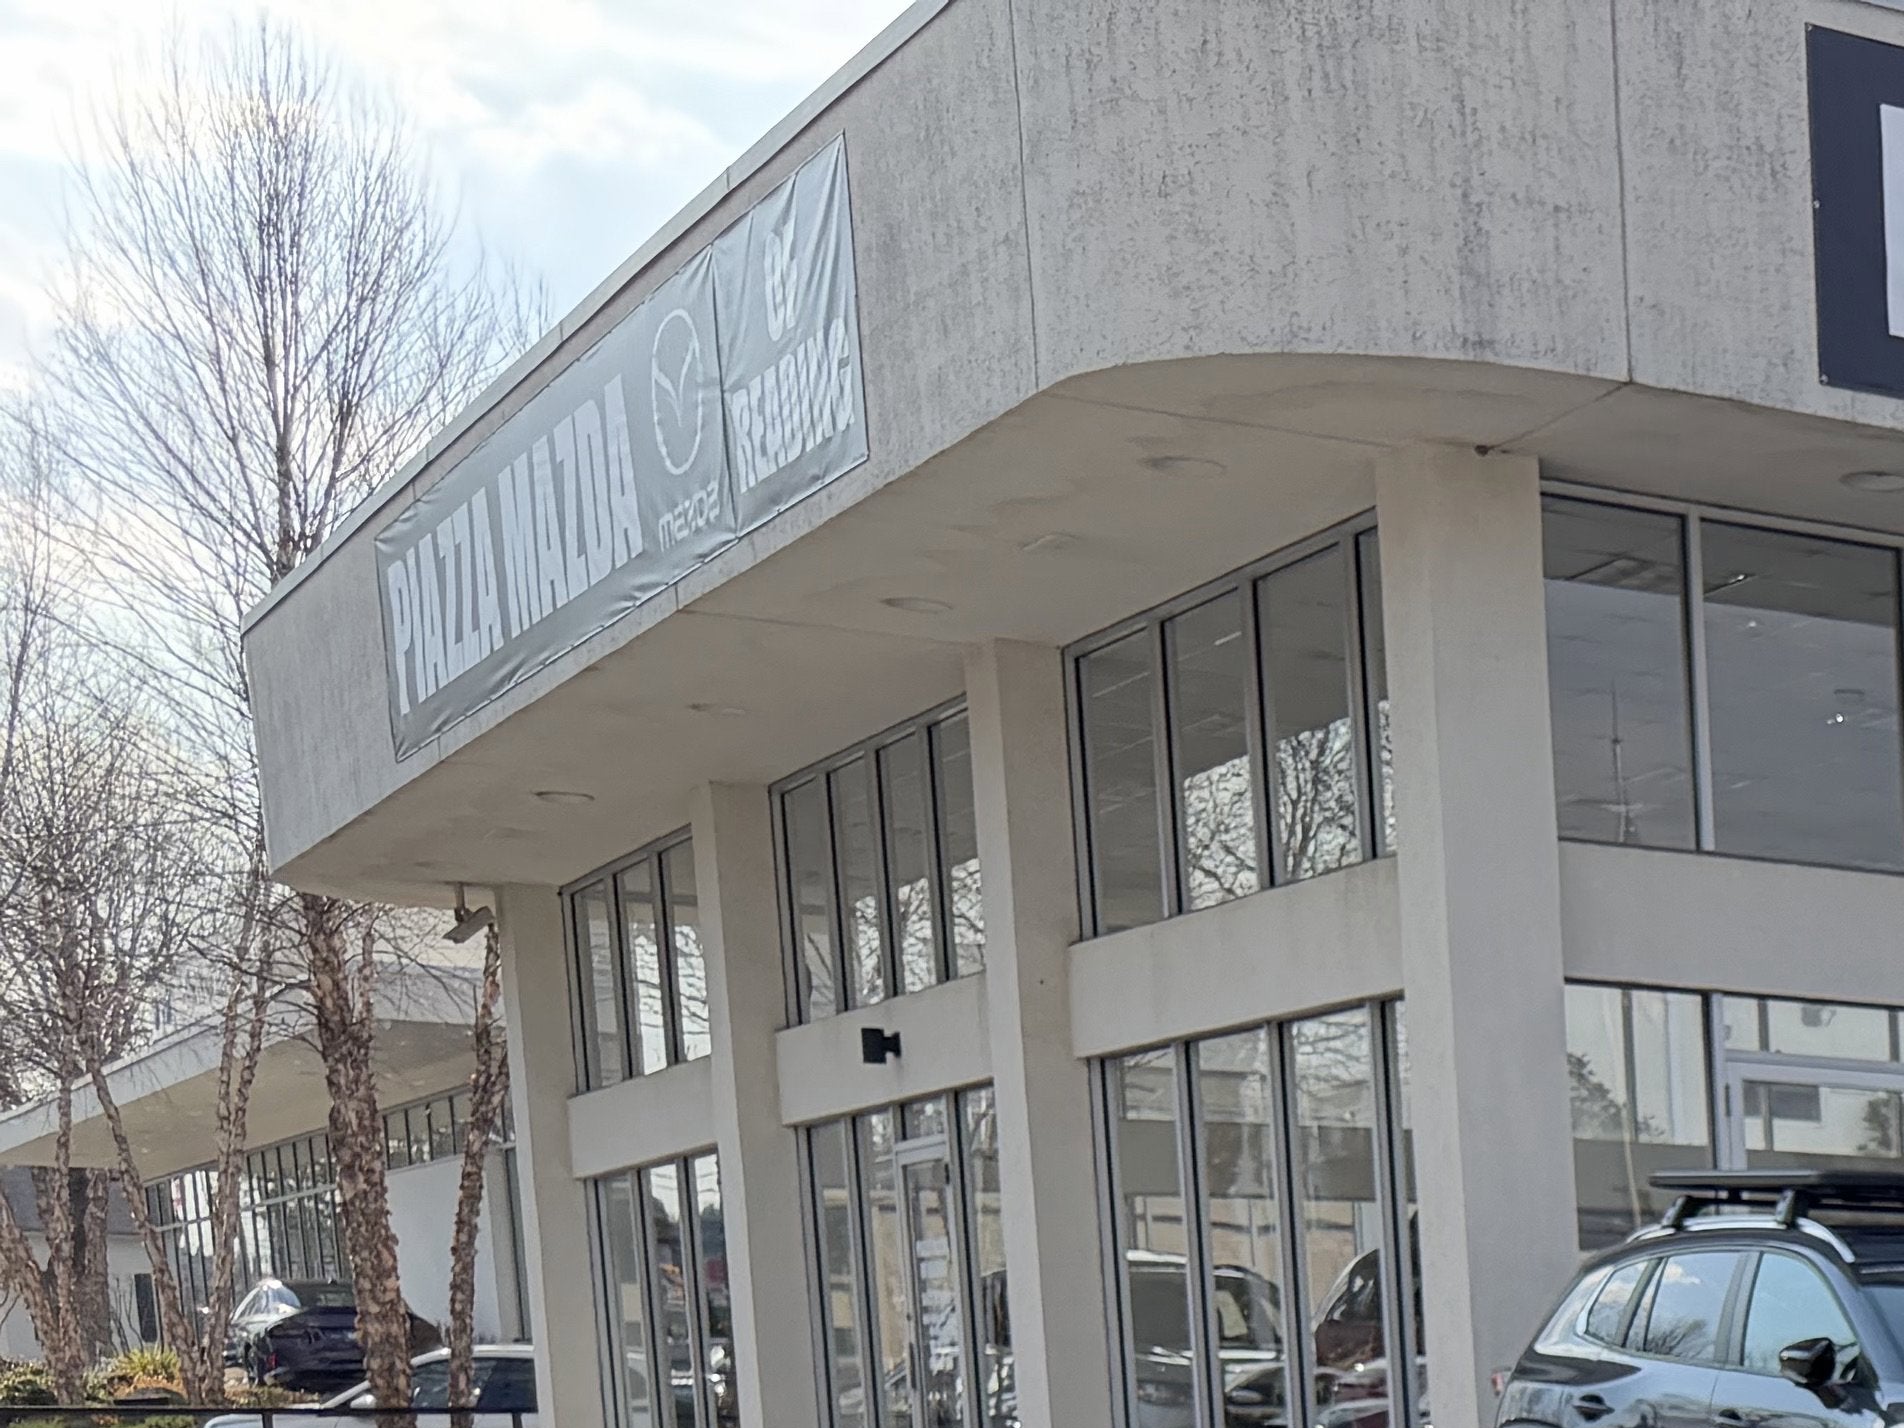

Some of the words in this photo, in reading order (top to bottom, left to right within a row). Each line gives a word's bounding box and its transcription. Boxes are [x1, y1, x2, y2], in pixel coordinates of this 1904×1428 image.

[762, 220, 800, 342] OF
[727, 315, 855, 495] READING
[387, 485, 505, 717] PIAZZA
[496, 374, 644, 639] MAZDA
